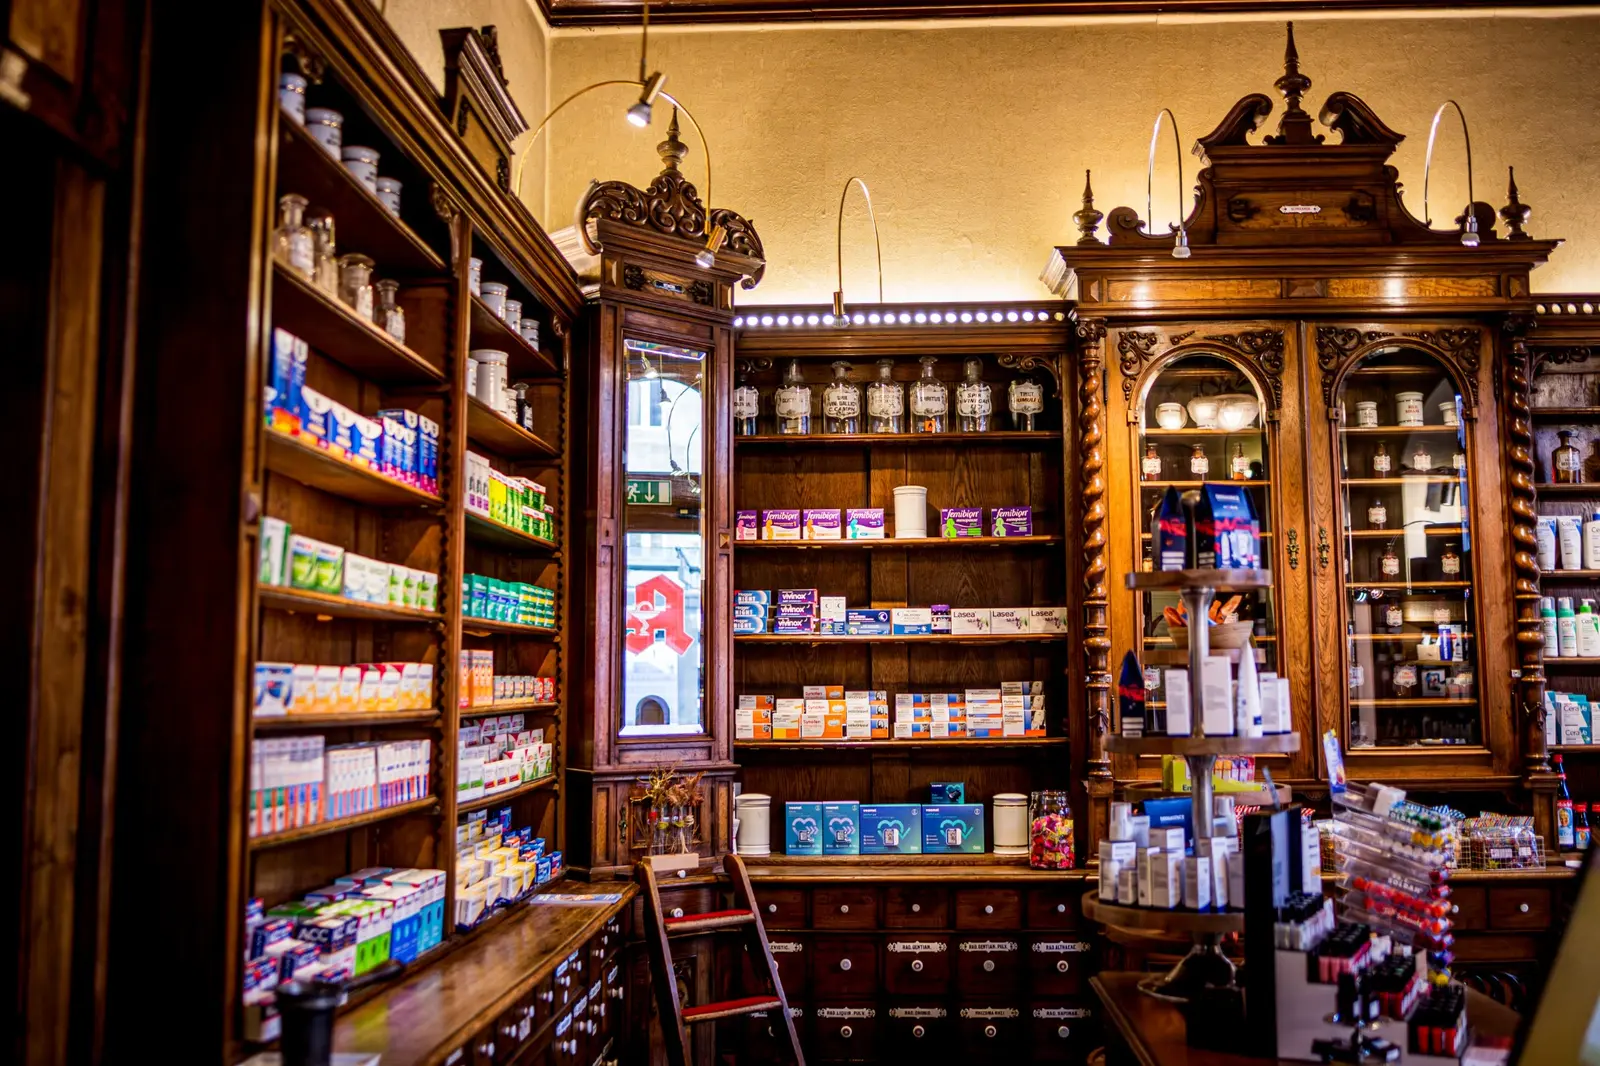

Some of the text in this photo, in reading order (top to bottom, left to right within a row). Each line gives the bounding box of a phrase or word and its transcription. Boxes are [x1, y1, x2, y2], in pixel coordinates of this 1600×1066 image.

[763, 511, 799, 522] femibion
[804, 510, 839, 521] femibion
[847, 510, 882, 521] femibion
[944, 508, 979, 520] femibion
[993, 508, 1028, 520] femibion
[298, 928, 329, 942] ACC
